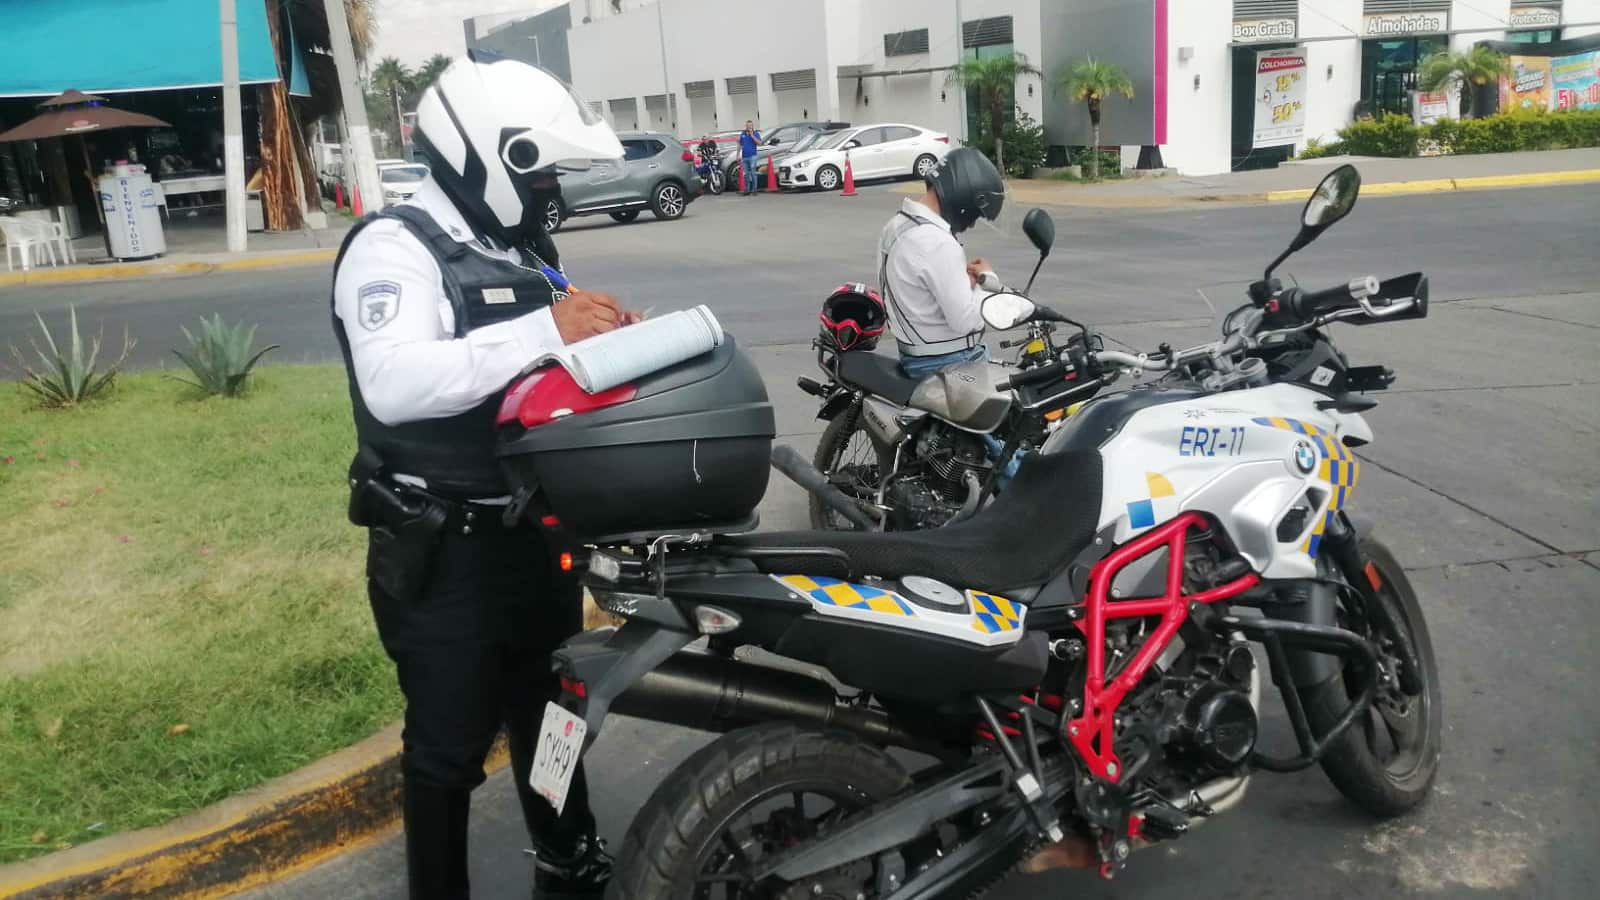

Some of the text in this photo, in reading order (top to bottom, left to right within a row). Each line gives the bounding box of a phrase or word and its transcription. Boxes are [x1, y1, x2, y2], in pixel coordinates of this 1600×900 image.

[1233, 20, 1295, 37] Box Gratis
[1368, 15, 1440, 33] Almohadas
[1179, 426, 1245, 457] ERI-11
